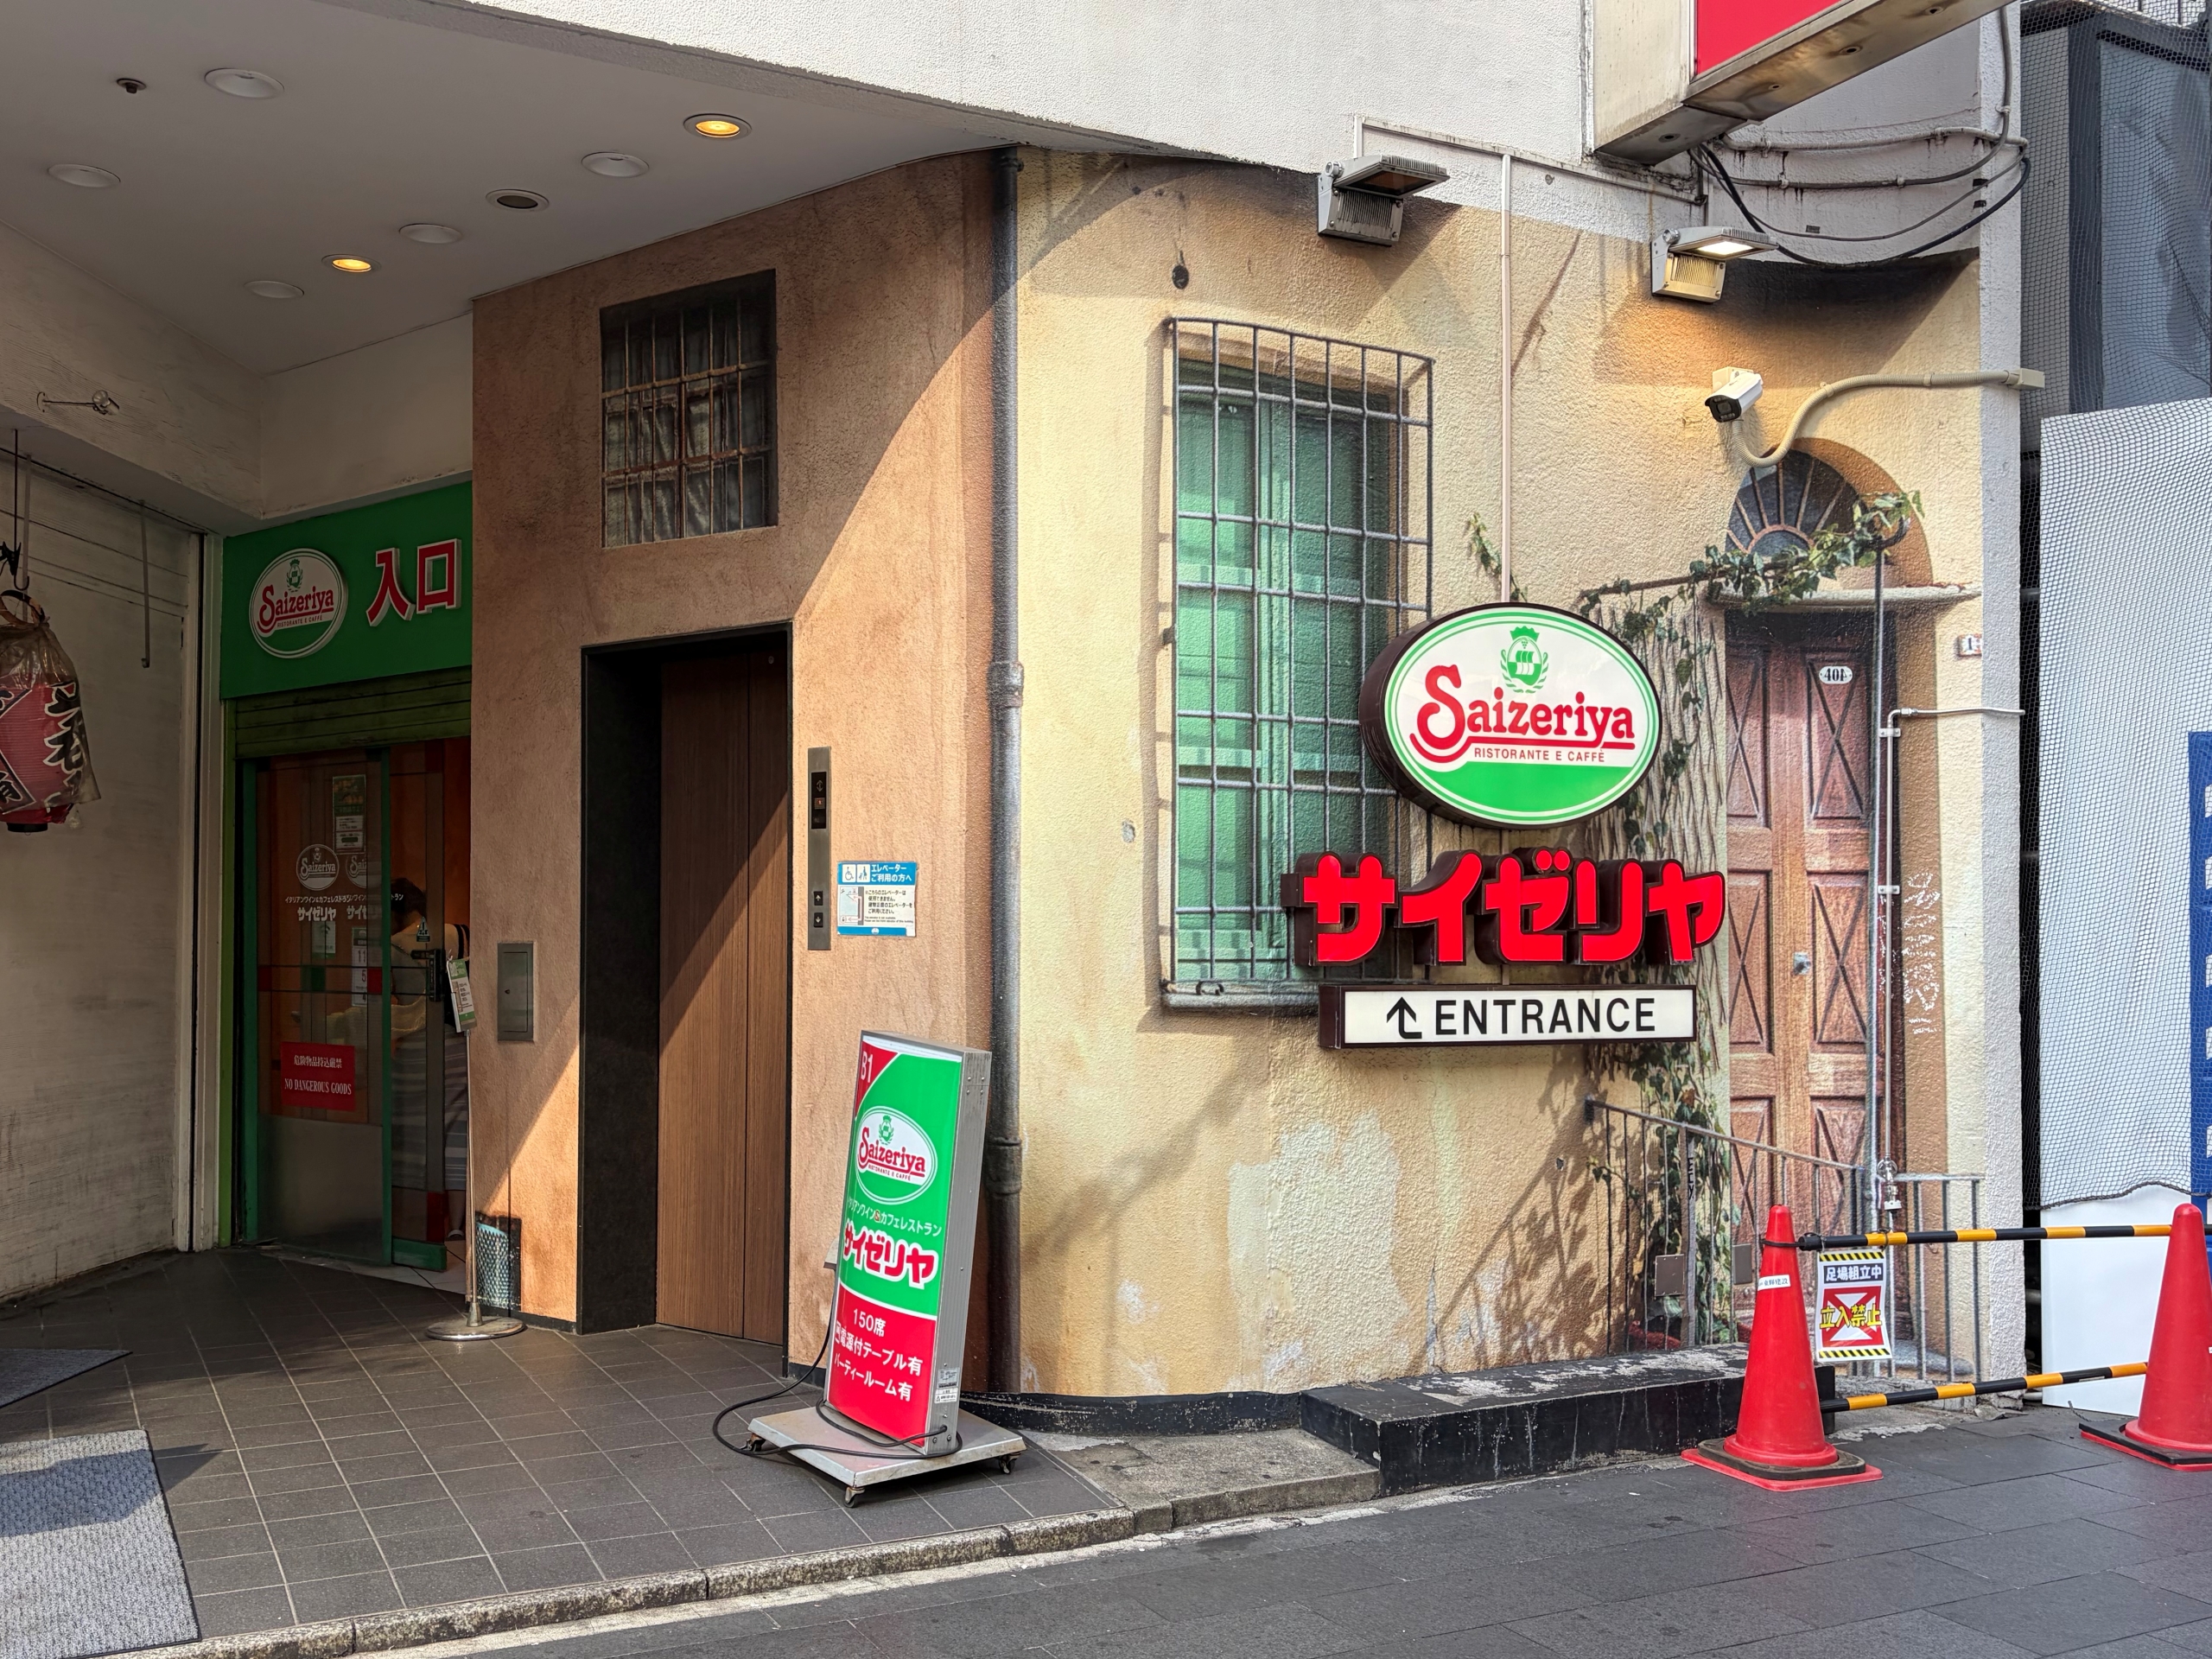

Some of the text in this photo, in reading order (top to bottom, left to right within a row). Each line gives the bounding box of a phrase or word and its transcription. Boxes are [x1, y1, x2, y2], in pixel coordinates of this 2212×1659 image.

[365, 537, 462, 627] 入口
[257, 584, 334, 634] Saizeriya
[1409, 664, 1636, 764] Saizeriya
[1474, 747, 1551, 762] RISTORANTE
[1555, 749, 1564, 762] E
[300, 857, 336, 880] Saizeriya
[871, 863, 906, 873] エレベーター
[871, 874, 912, 882] ご利用の方へ
[296, 906, 337, 922] サイゼリヤ
[1303, 849, 1726, 963] サイゼリヤ
[1435, 998, 1656, 1035] ENTRANCE
[860, 1051, 874, 1084] B1
[284, 1077, 352, 1096] NO DANGEROUS GOODS
[857, 1126, 925, 1178] Saizeriya
[844, 1219, 939, 1288] サイゼリヤ
[1826, 1265, 1882, 1282] 足場組立中
[853, 1308, 887, 1338] 150席
[1820, 1303, 1882, 1329] 立入禁止
